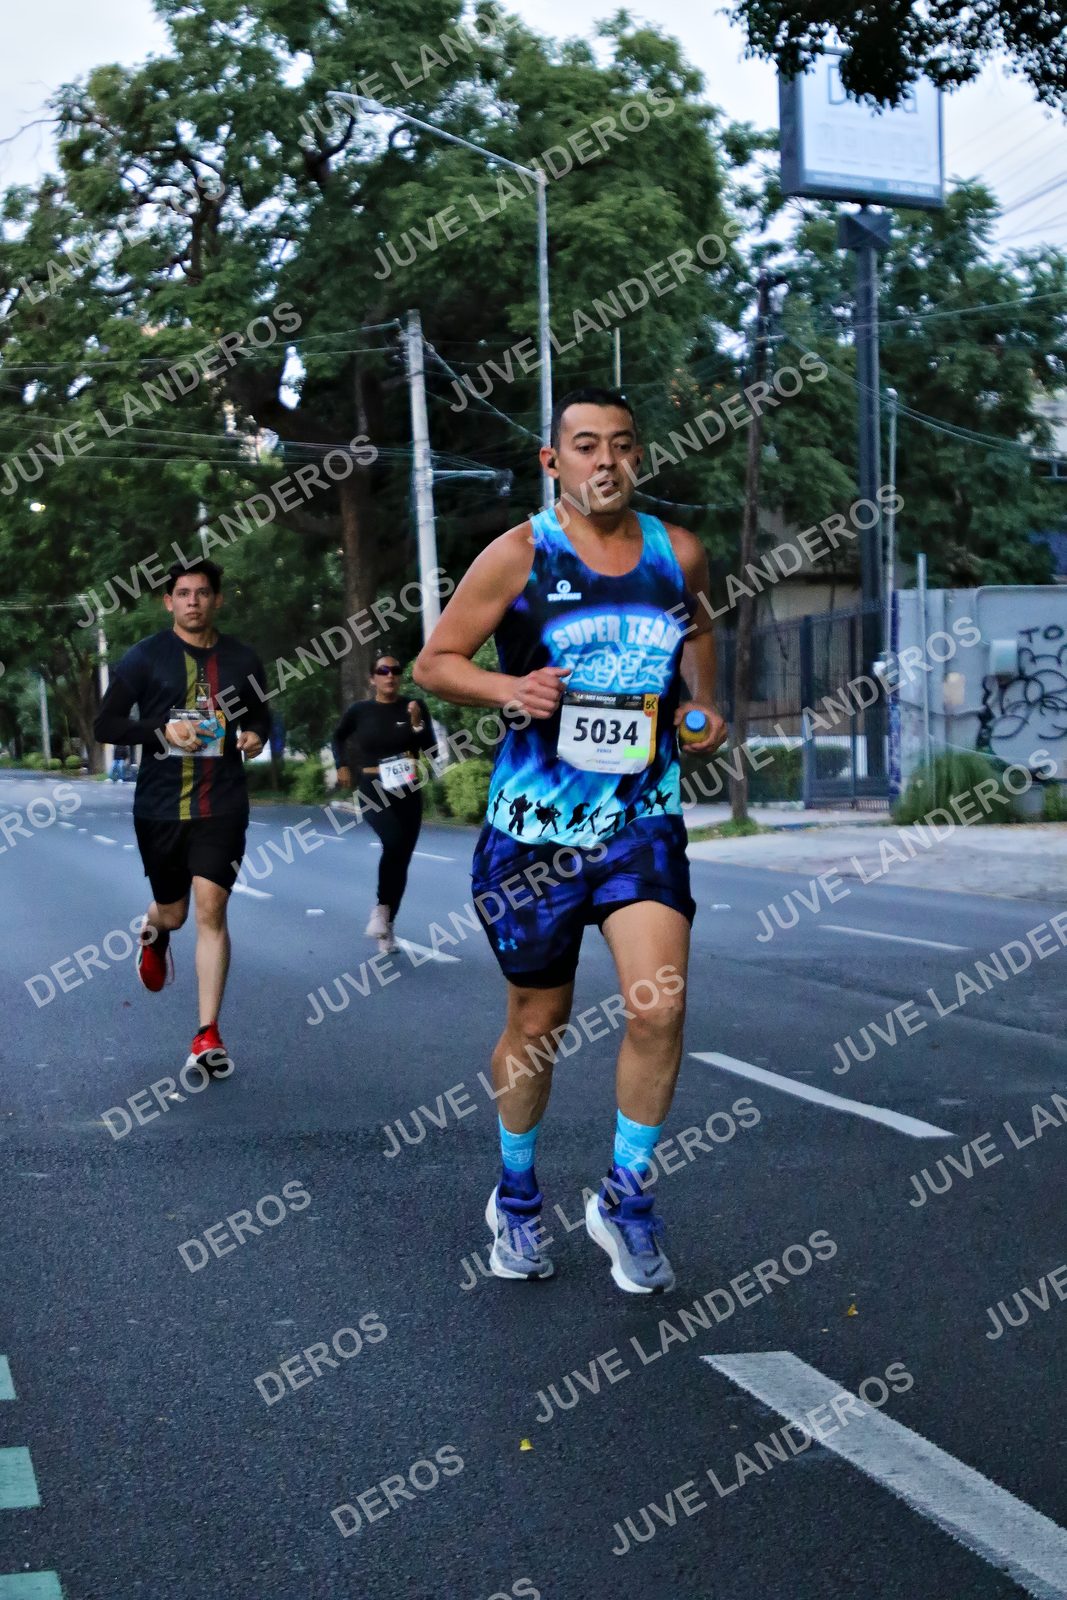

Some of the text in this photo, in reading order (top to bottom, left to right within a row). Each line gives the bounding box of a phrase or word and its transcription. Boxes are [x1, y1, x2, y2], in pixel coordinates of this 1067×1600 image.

[551, 614, 621, 650] SUPER
[645, 700, 656, 709] 5K
[573, 716, 638, 746] 5034
